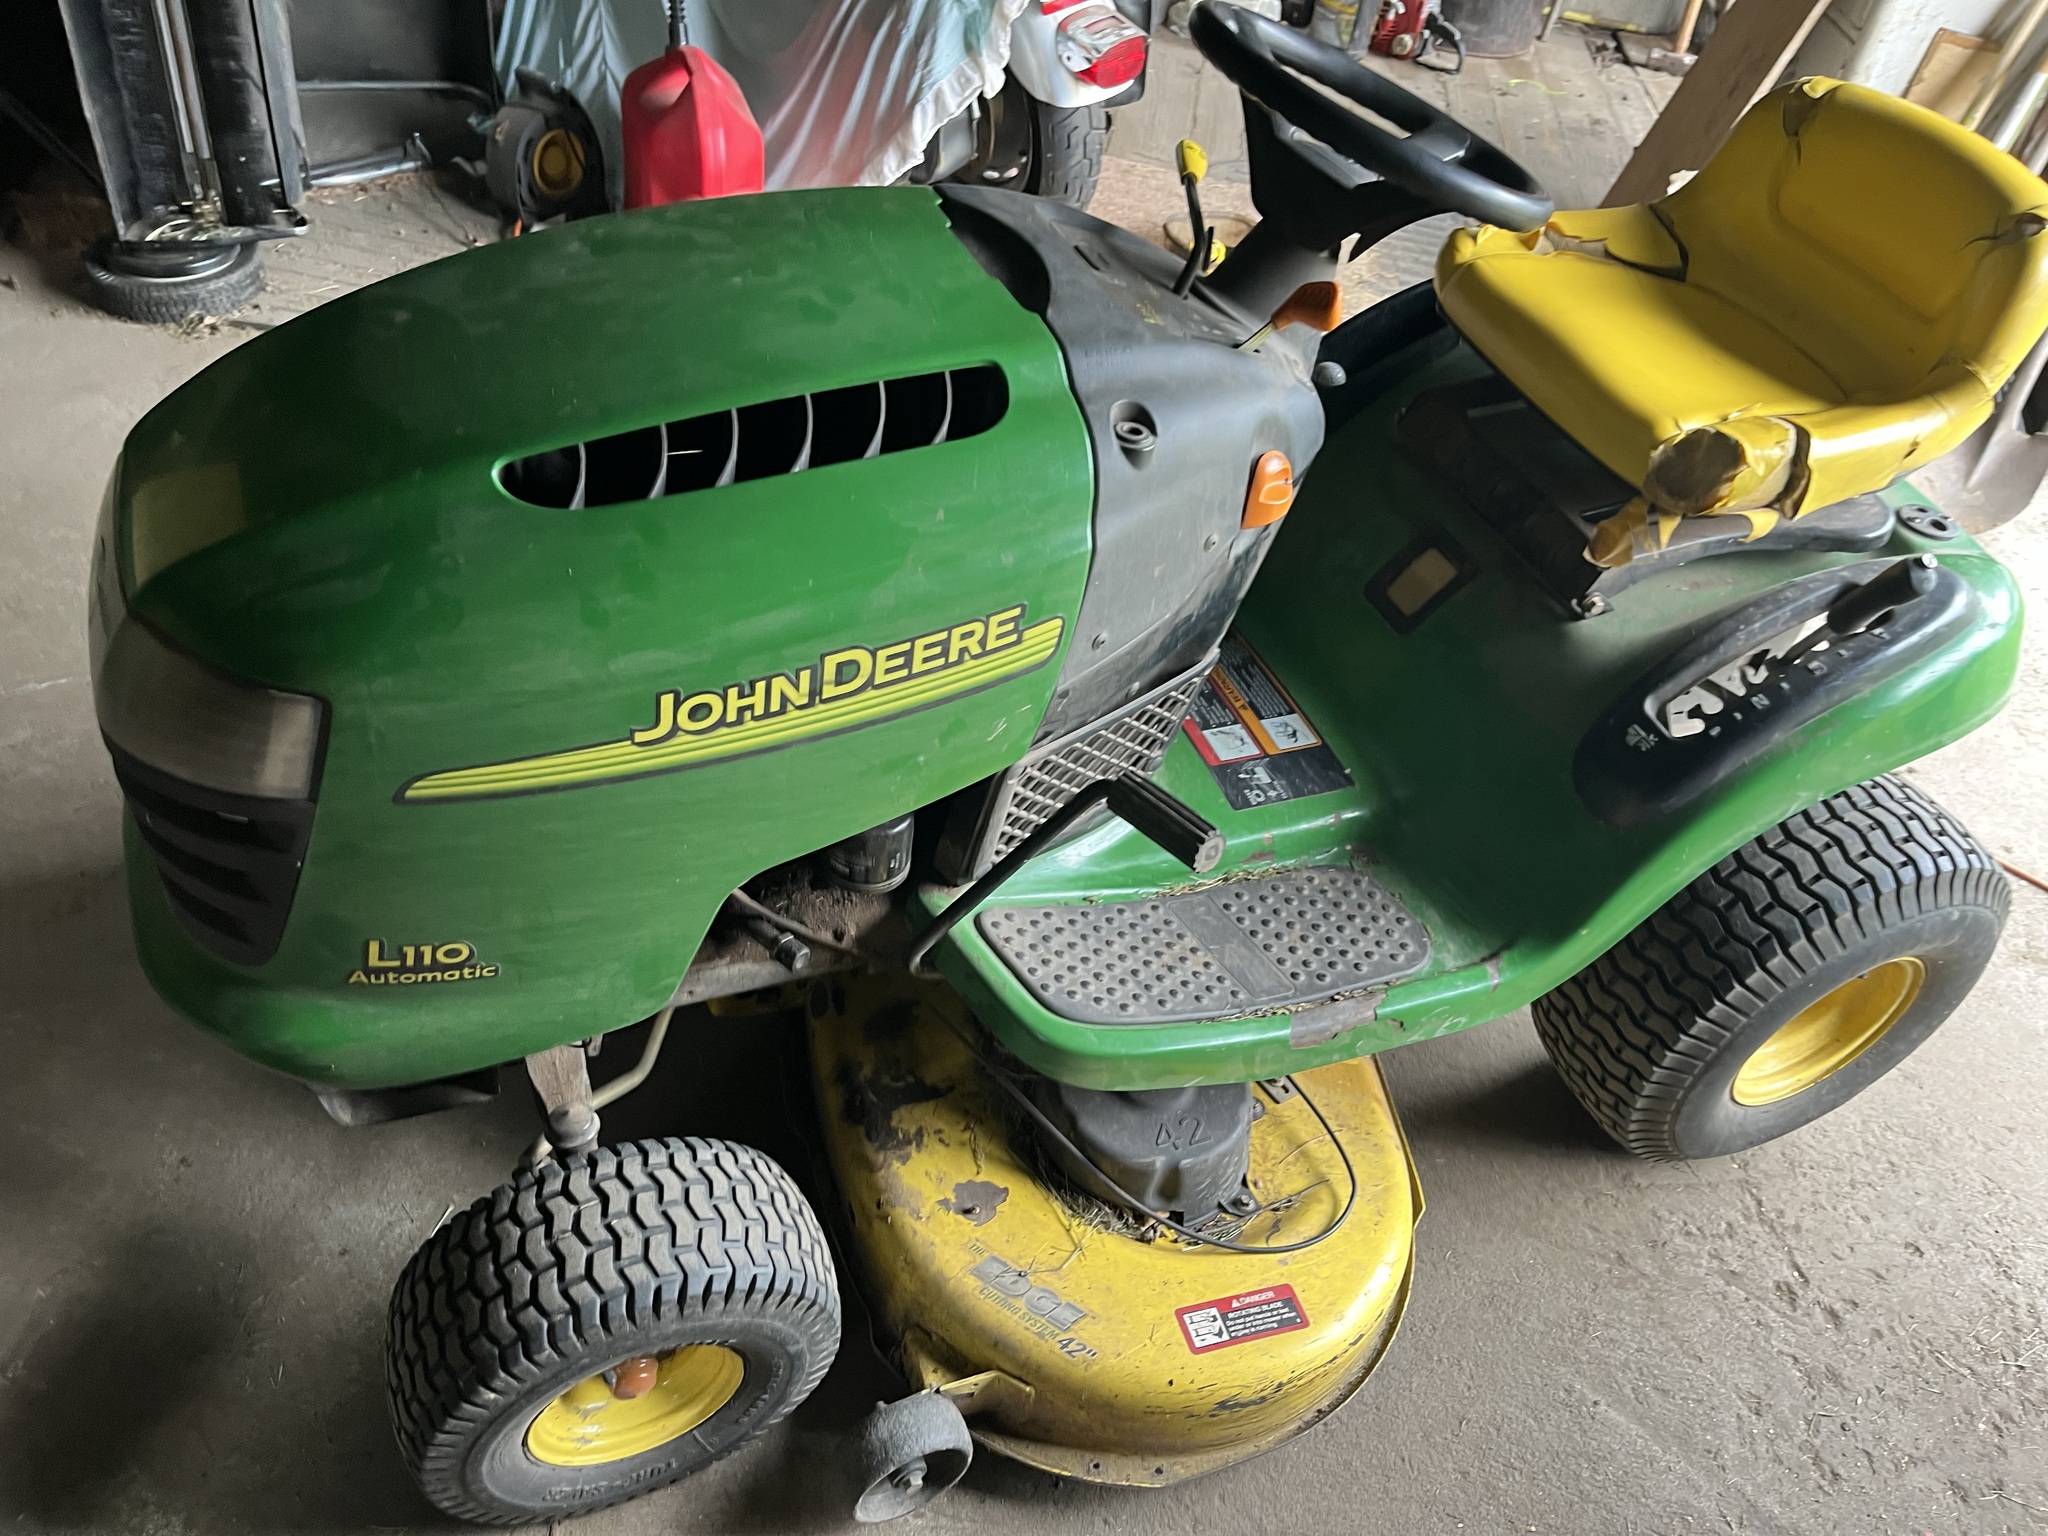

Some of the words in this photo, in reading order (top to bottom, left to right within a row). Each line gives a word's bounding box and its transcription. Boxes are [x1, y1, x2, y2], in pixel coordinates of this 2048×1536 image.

[632, 667, 813, 745] JOHN
[820, 605, 1024, 701] DEERE
[367, 939, 471, 968] L110
[348, 964, 497, 985] Automatic
[1155, 1116, 1214, 1151] 42
[1227, 1306, 1262, 1319] ROTATING
[1261, 1301, 1284, 1311] BLADE
[1239, 1291, 1275, 1305] DANGER
[1018, 1311, 1061, 1340] SYSTEM
[1057, 1337, 1098, 1359] 42"
